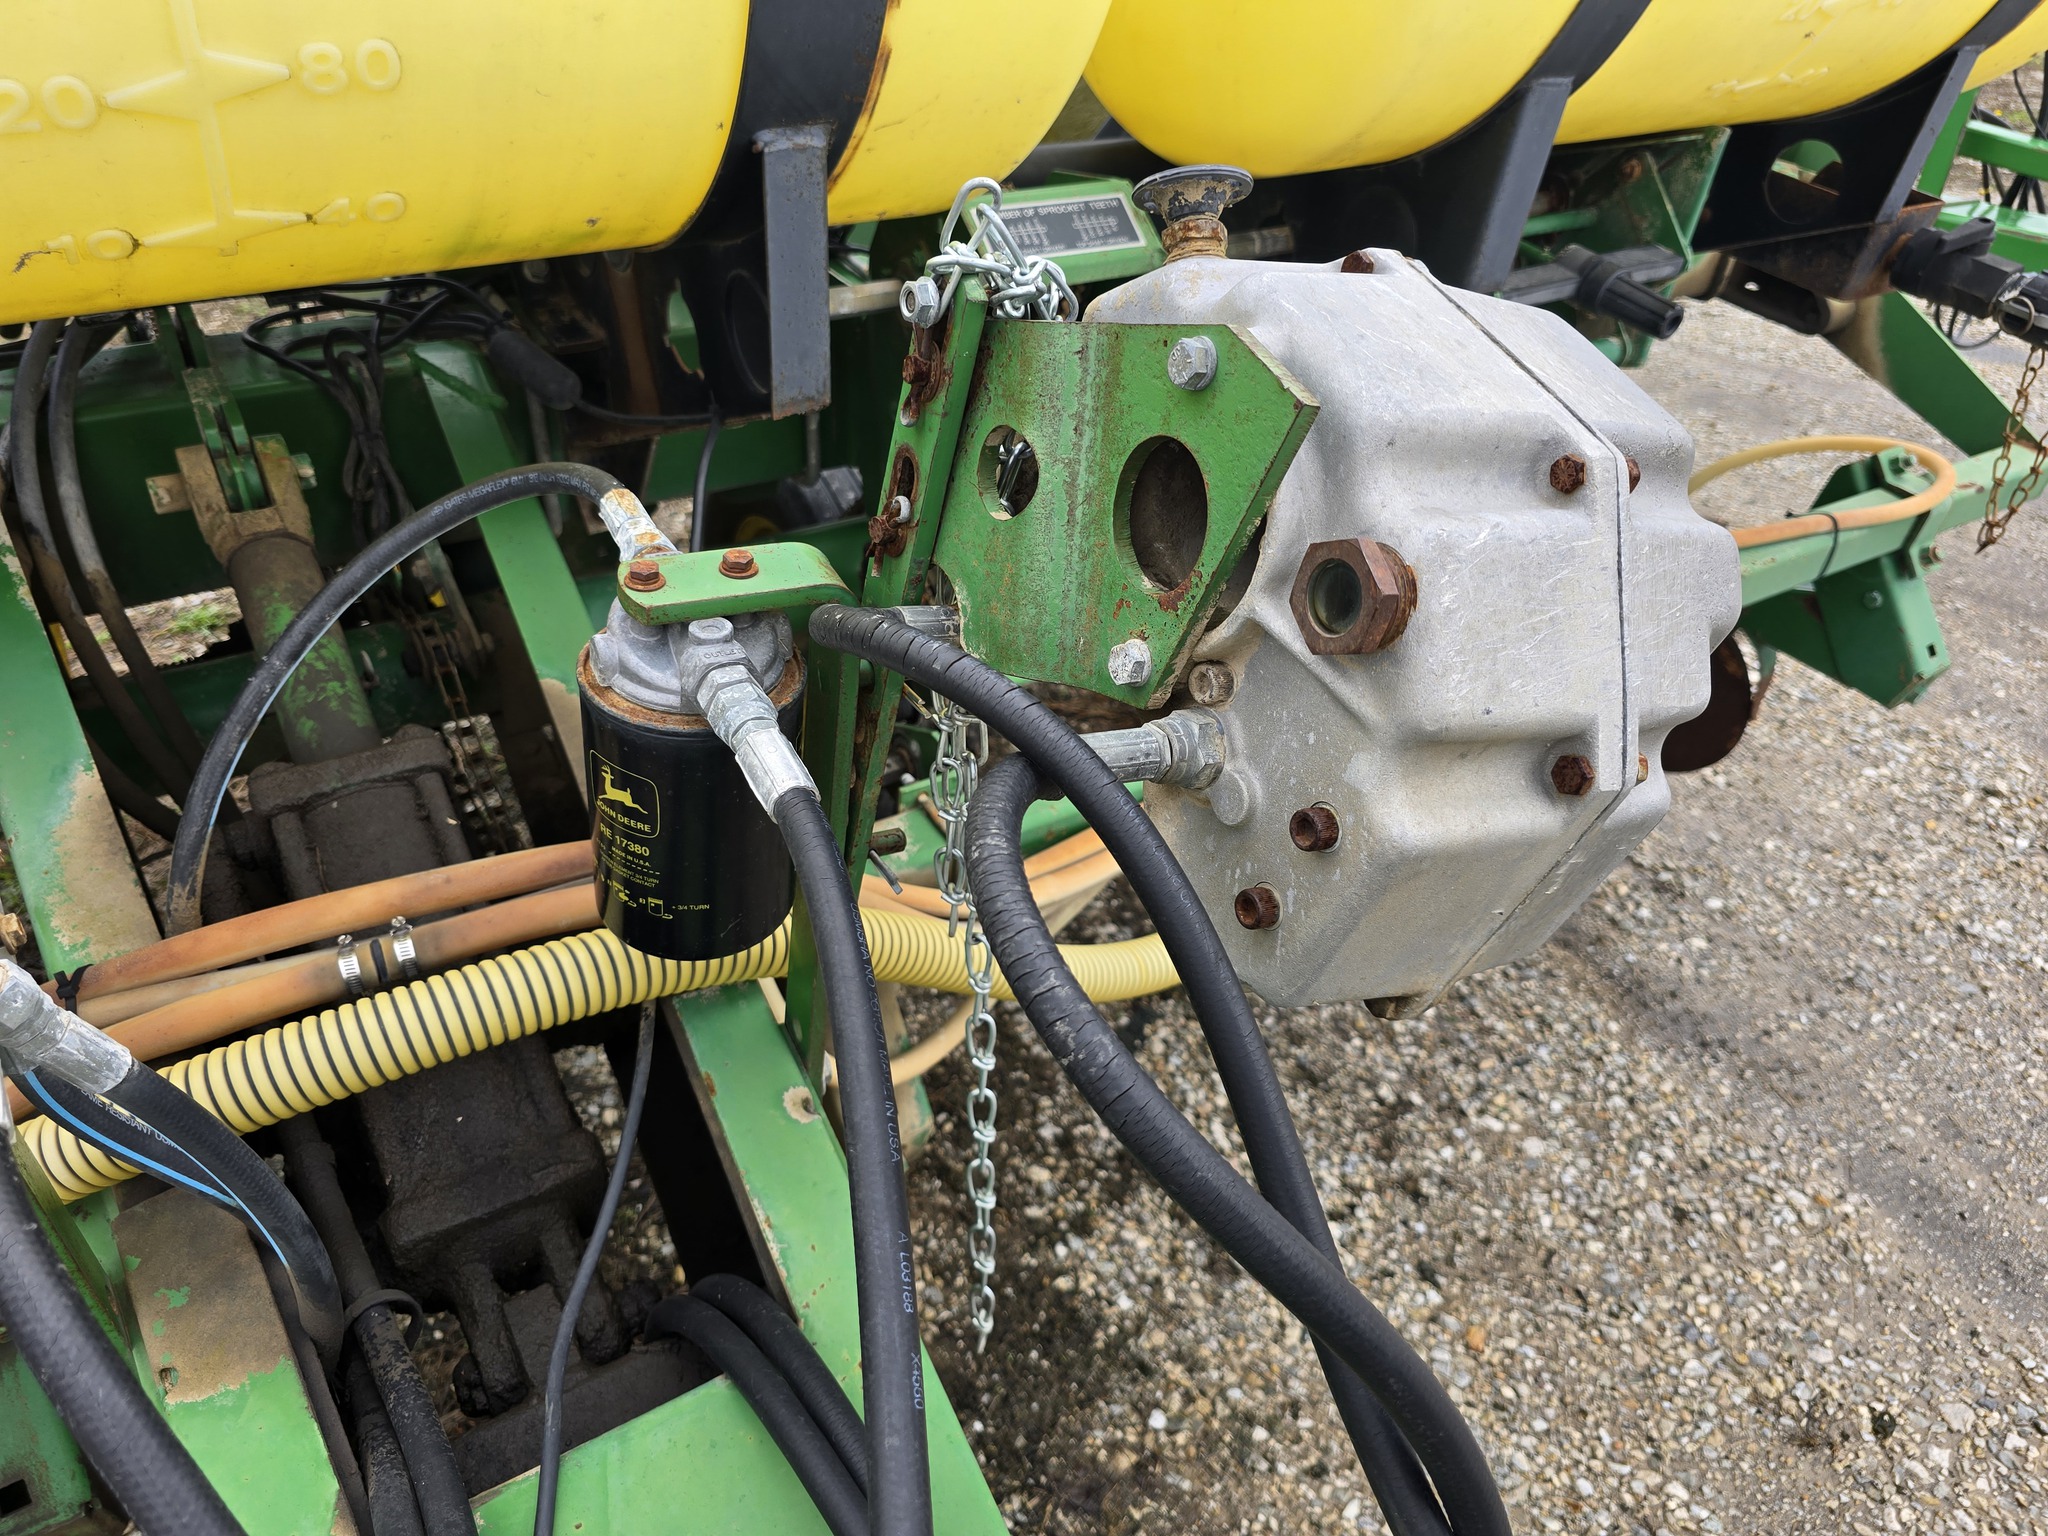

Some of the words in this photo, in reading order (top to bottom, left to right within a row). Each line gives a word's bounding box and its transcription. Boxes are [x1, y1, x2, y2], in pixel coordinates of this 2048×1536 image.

[299, 38, 402, 95] 80
[314, 191, 407, 228] 40
[1023, 207, 1036, 218] OF
[1037, 203, 1085, 216] SPROCKET
[1089, 199, 1120, 210] TEETH
[45, 228, 138, 265] 10
[704, 647, 742, 659] OUTLET
[596, 798, 616, 819] JOHN
[618, 814, 651, 832] DEERE
[600, 822, 613, 840] RE
[615, 835, 650, 857] 17380
[611, 846, 626, 858] MADE
[105, 1106, 150, 1135] RESISTANT
[885, 1101, 896, 1117] IN
[898, 1231, 909, 1243] A
[899, 1252, 914, 1314] L03188
